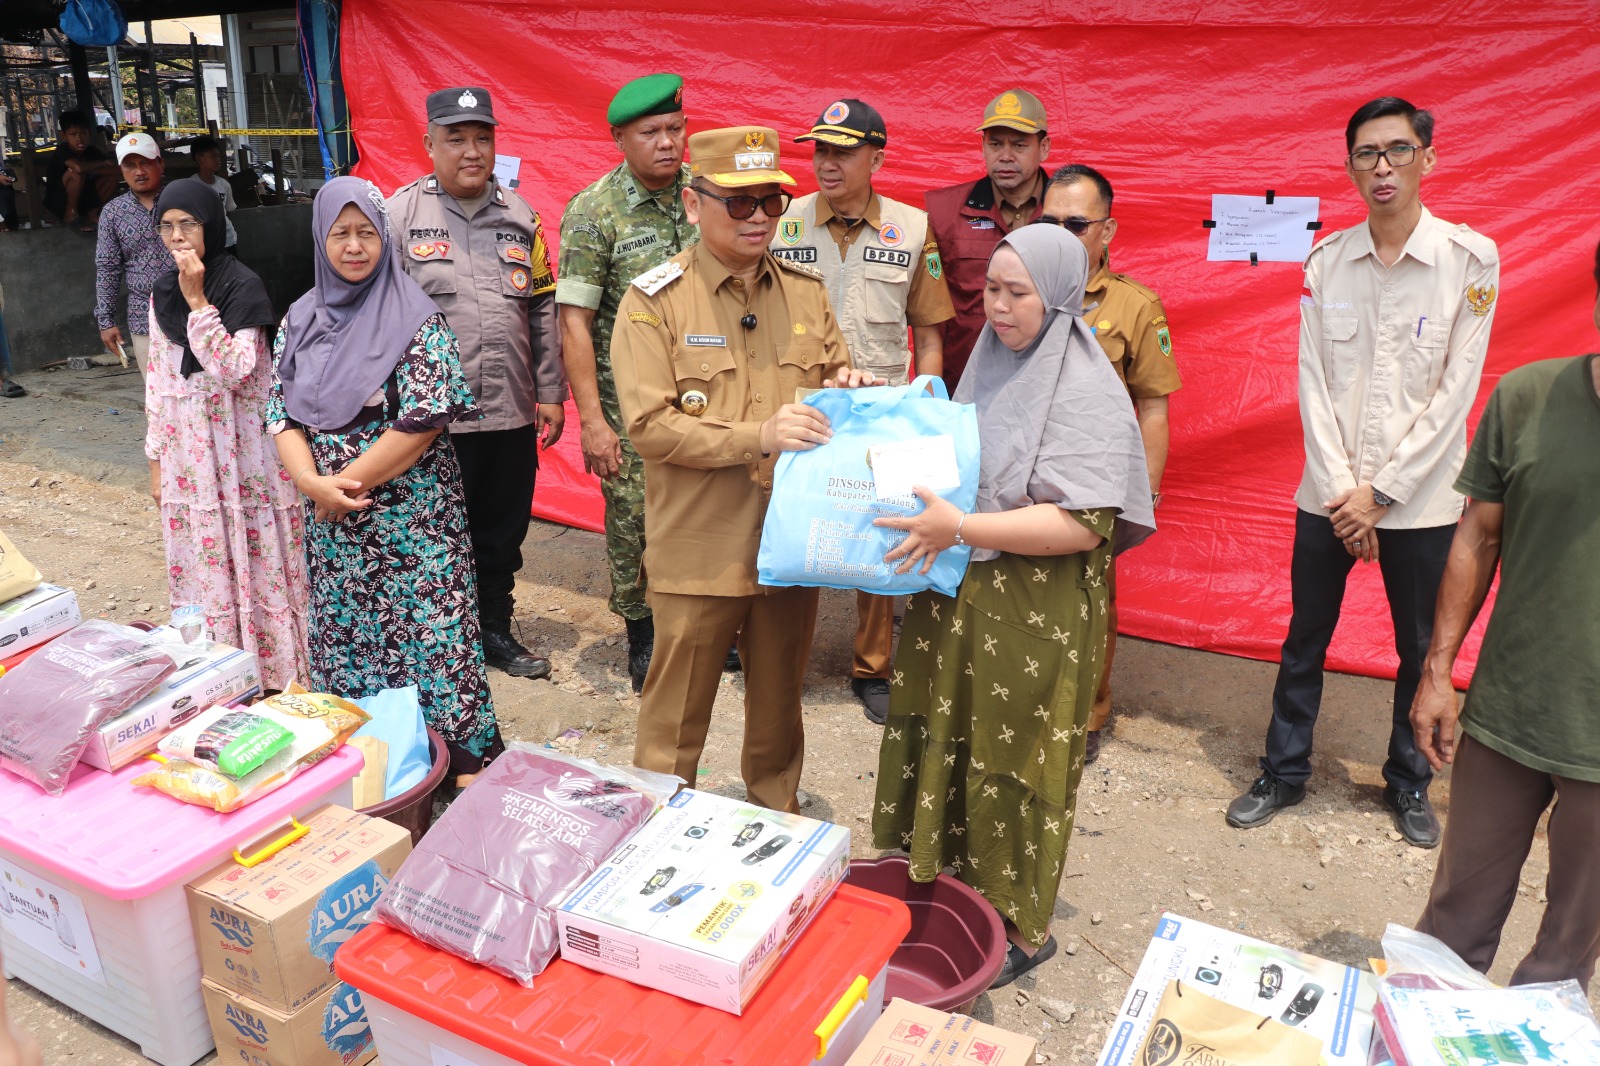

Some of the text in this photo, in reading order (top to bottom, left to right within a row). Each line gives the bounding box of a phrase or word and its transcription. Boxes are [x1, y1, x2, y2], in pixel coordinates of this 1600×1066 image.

[496, 232, 531, 247] POLRI
[869, 250, 906, 264] BPBD
[827, 489, 916, 510] Kabupaten abalong
[117, 714, 156, 743] SEKAI
[237, 731, 282, 764] nusakita
[501, 792, 591, 836] #KEMENSOS
[394, 881, 426, 898] BANTUAN
[452, 905, 481, 921] SELIMUT
[582, 875, 621, 911] KOMPOR
[619, 860, 639, 875] GAS
[9, 892, 49, 919] BANTUAN
[314, 872, 390, 936] AURA
[696, 901, 728, 934] PEMANTIK
[210, 907, 254, 938] AURA
[444, 923, 473, 939] MANDIRI
[708, 904, 746, 942] 10.000X
[748, 927, 777, 972] SEKAI
[225, 1003, 268, 1034] AURA
[292, 1000, 300, 1008] 48
[329, 988, 365, 1030] AU
